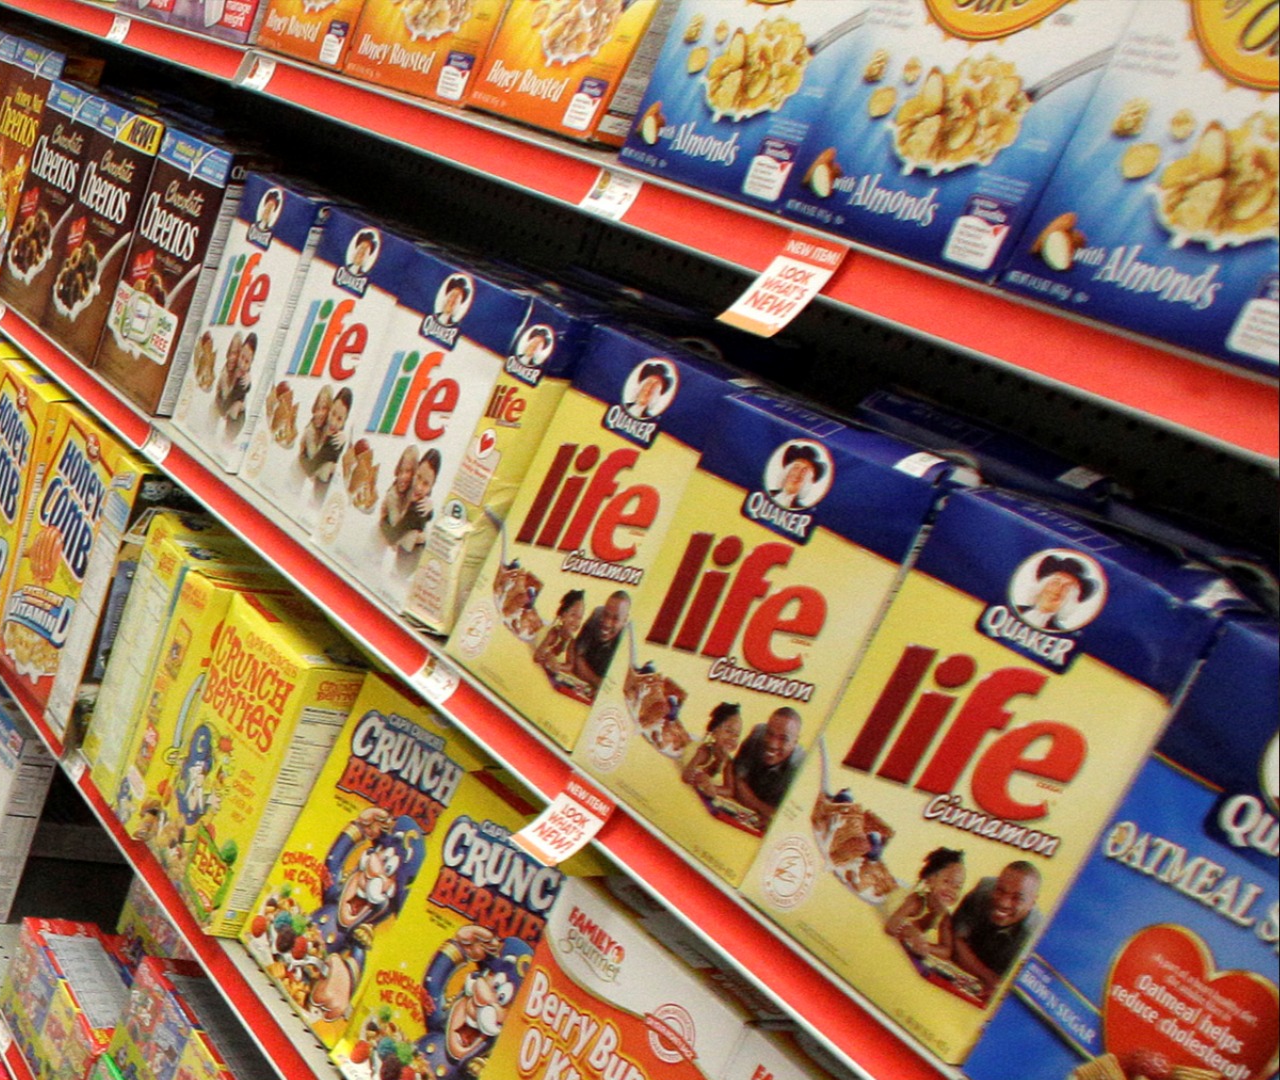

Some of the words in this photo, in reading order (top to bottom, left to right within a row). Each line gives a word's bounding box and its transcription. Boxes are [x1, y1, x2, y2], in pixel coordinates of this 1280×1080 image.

[359, 37, 392, 63] Honey
[391, 46, 435, 74] Roasted
[487, 61, 518, 89] Honey
[517, 69, 567, 101] Roasted
[31, 135, 78, 193] Cheerios
[53, 124, 82, 156] Chocolate
[81, 160, 130, 224] Cheerios
[164, 182, 203, 216] Chocolate
[848, 174, 939, 225] Almonds
[144, 192, 200, 262] Cheerios
[787, 240, 814, 258] NEW
[812, 246, 841, 265] ITEM!
[209, 253, 270, 327] life
[746, 291, 792, 318] NEW!
[779, 264, 815, 289] LOOK
[1074, 249, 1105, 265] with
[1099, 246, 1222, 308] Almonds
[286, 300, 368, 381] life
[422, 316, 458, 345] QUAKER
[365, 351, 460, 441] life
[608, 406, 657, 443] QUAKER
[60, 437, 104, 500] HONEY
[40, 478, 93, 579] COMB
[516, 443, 660, 560] life
[748, 492, 812, 535] QUAKER
[562, 549, 643, 584] Cinnamon
[646, 532, 827, 673] life
[984, 607, 1075, 663] QUAKER
[709, 657, 812, 701] Cinnamon
[352, 712, 463, 806] CRUNCH
[842, 645, 1086, 821] life
[339, 757, 441, 832] BERRIES
[924, 795, 1058, 855] Cinnamon
[1104, 821, 1255, 928] OATMEAL
[526, 973, 599, 1044] Berry
[1054, 1008, 1096, 1045] SUGAR
[1112, 984, 1156, 1023] reduce
[1156, 1016, 1250, 1080] cholesterol!
[1137, 973, 1198, 1032] Oatmeal
[1199, 1014, 1245, 1052] helps
